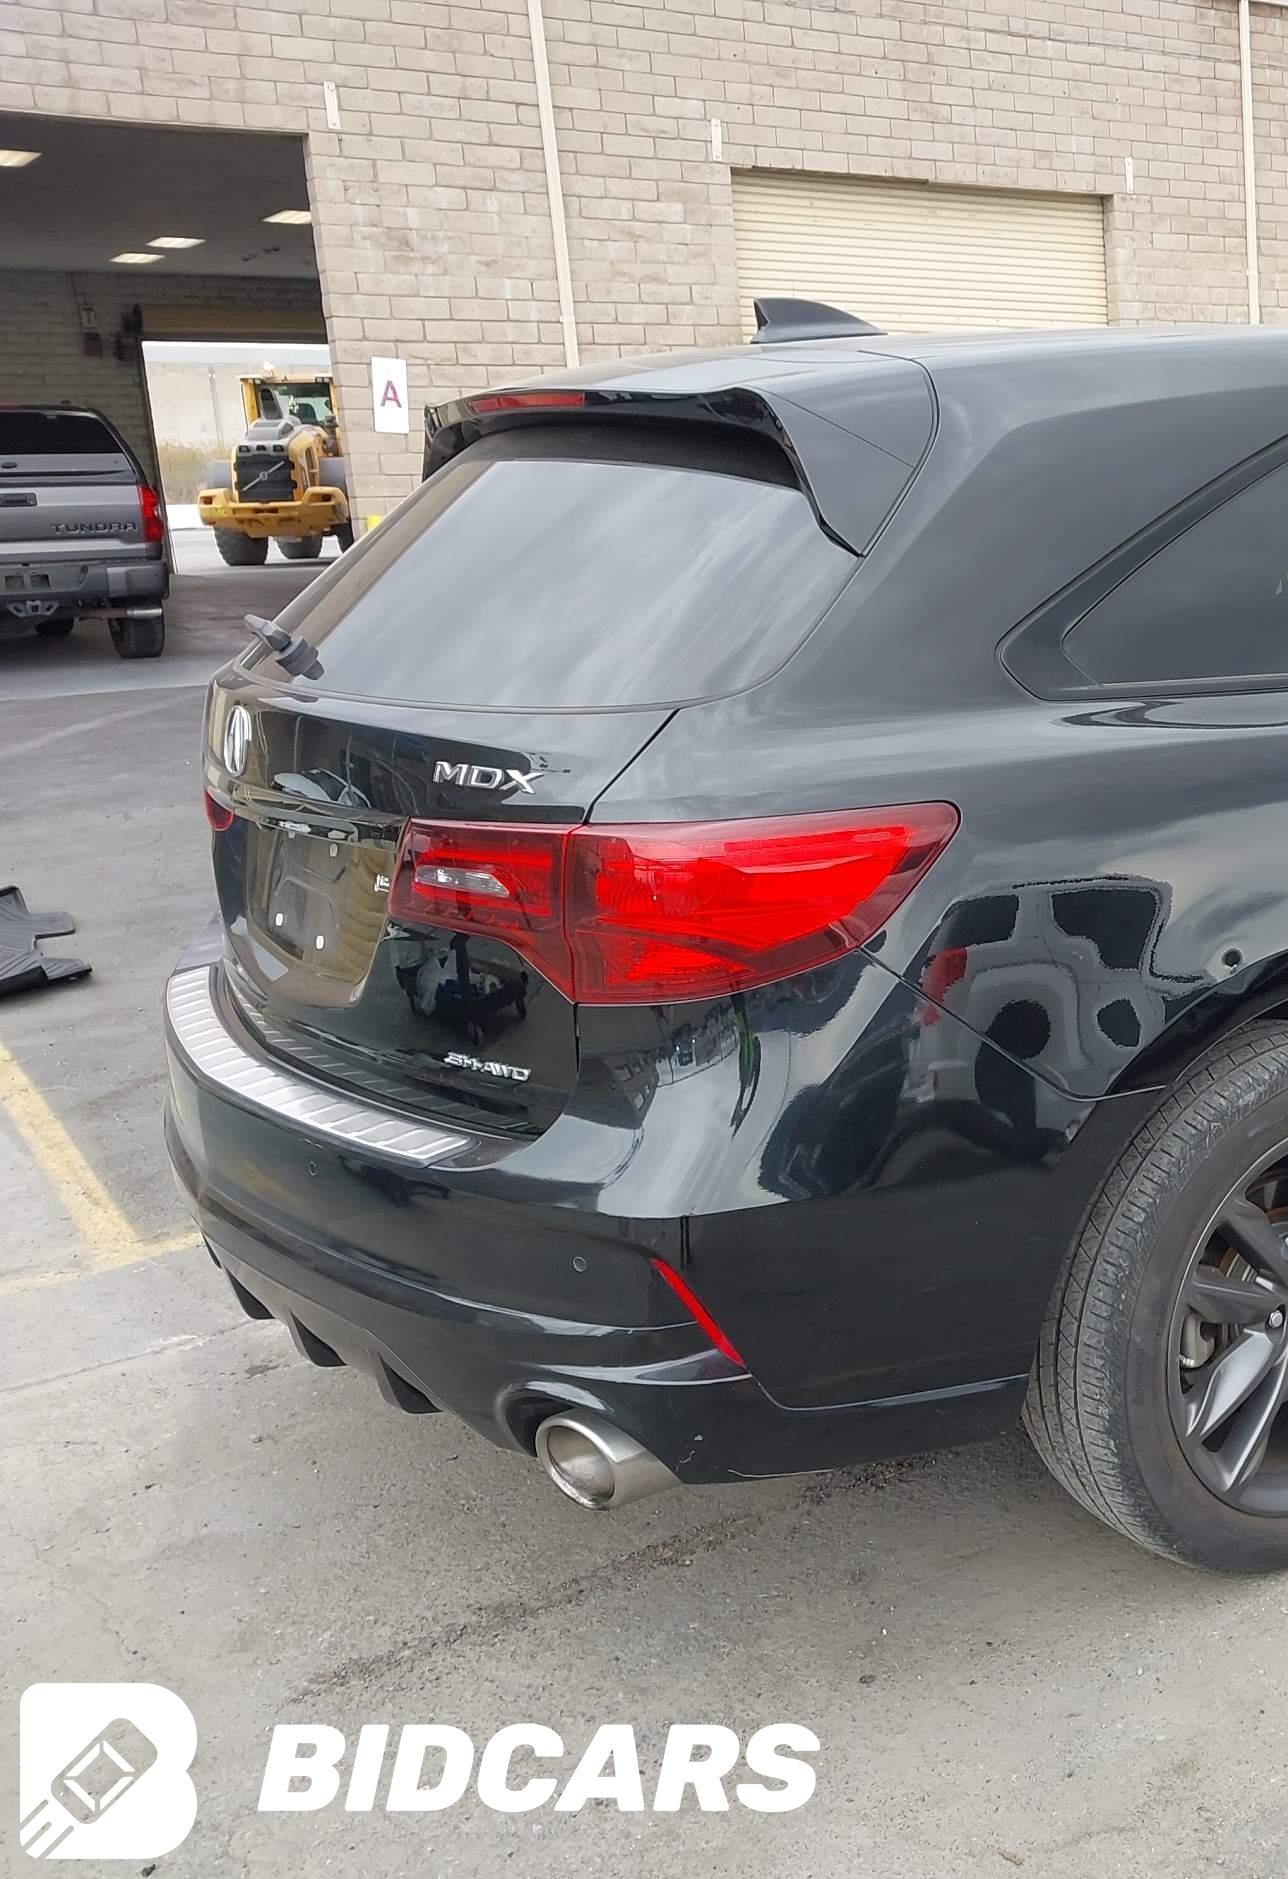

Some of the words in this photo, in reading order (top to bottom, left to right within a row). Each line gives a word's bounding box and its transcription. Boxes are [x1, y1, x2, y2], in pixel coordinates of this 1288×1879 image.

[380, 380, 402, 408] A
[50, 523, 138, 534] TUNDRA
[432, 761, 544, 794] MDX
